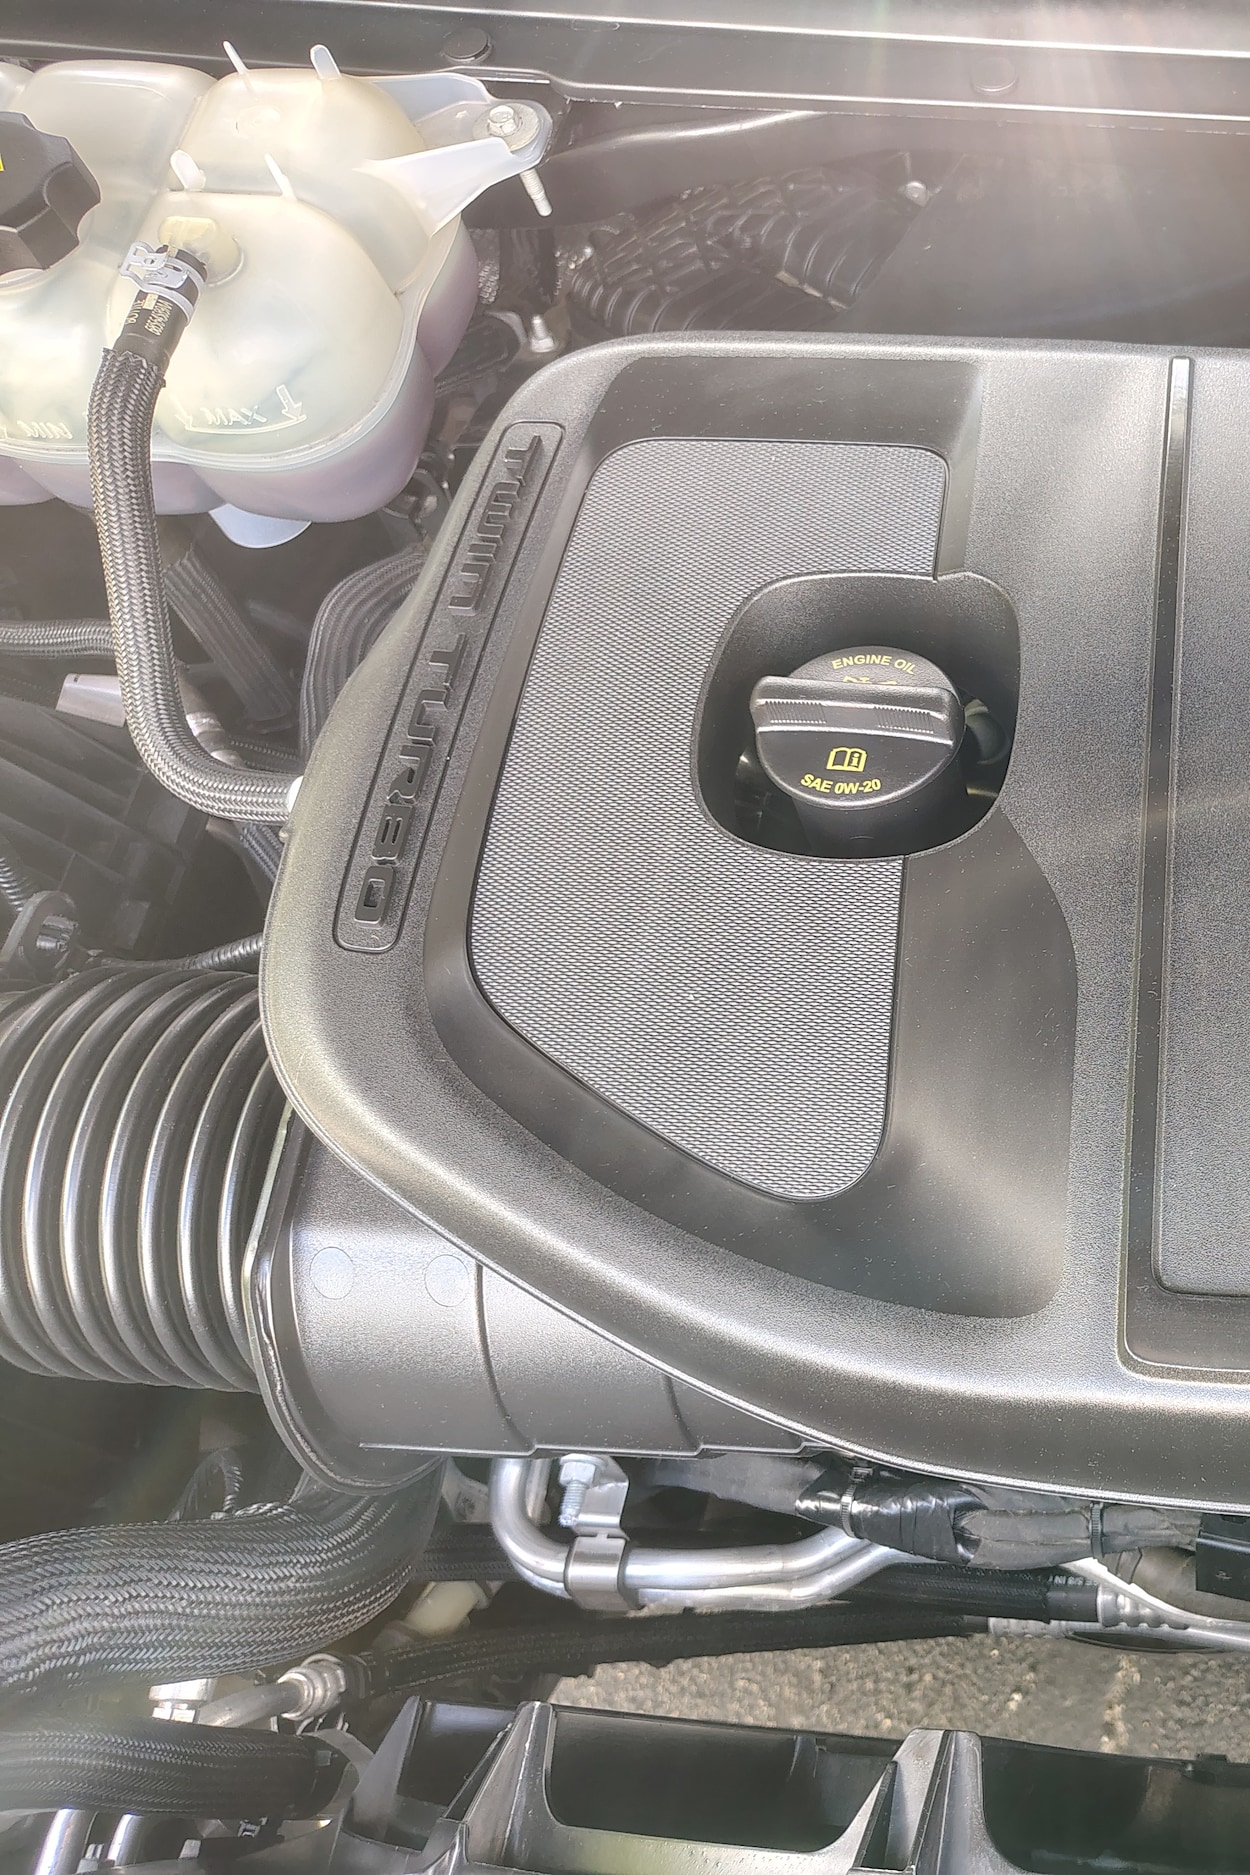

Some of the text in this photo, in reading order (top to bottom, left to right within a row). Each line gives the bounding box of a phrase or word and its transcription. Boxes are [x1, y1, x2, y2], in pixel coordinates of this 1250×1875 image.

[831, 654, 916, 675] ENGINE OIL
[354, 433, 545, 930] TWIN TURBO
[800, 774, 881, 795] SAE 0W-20
